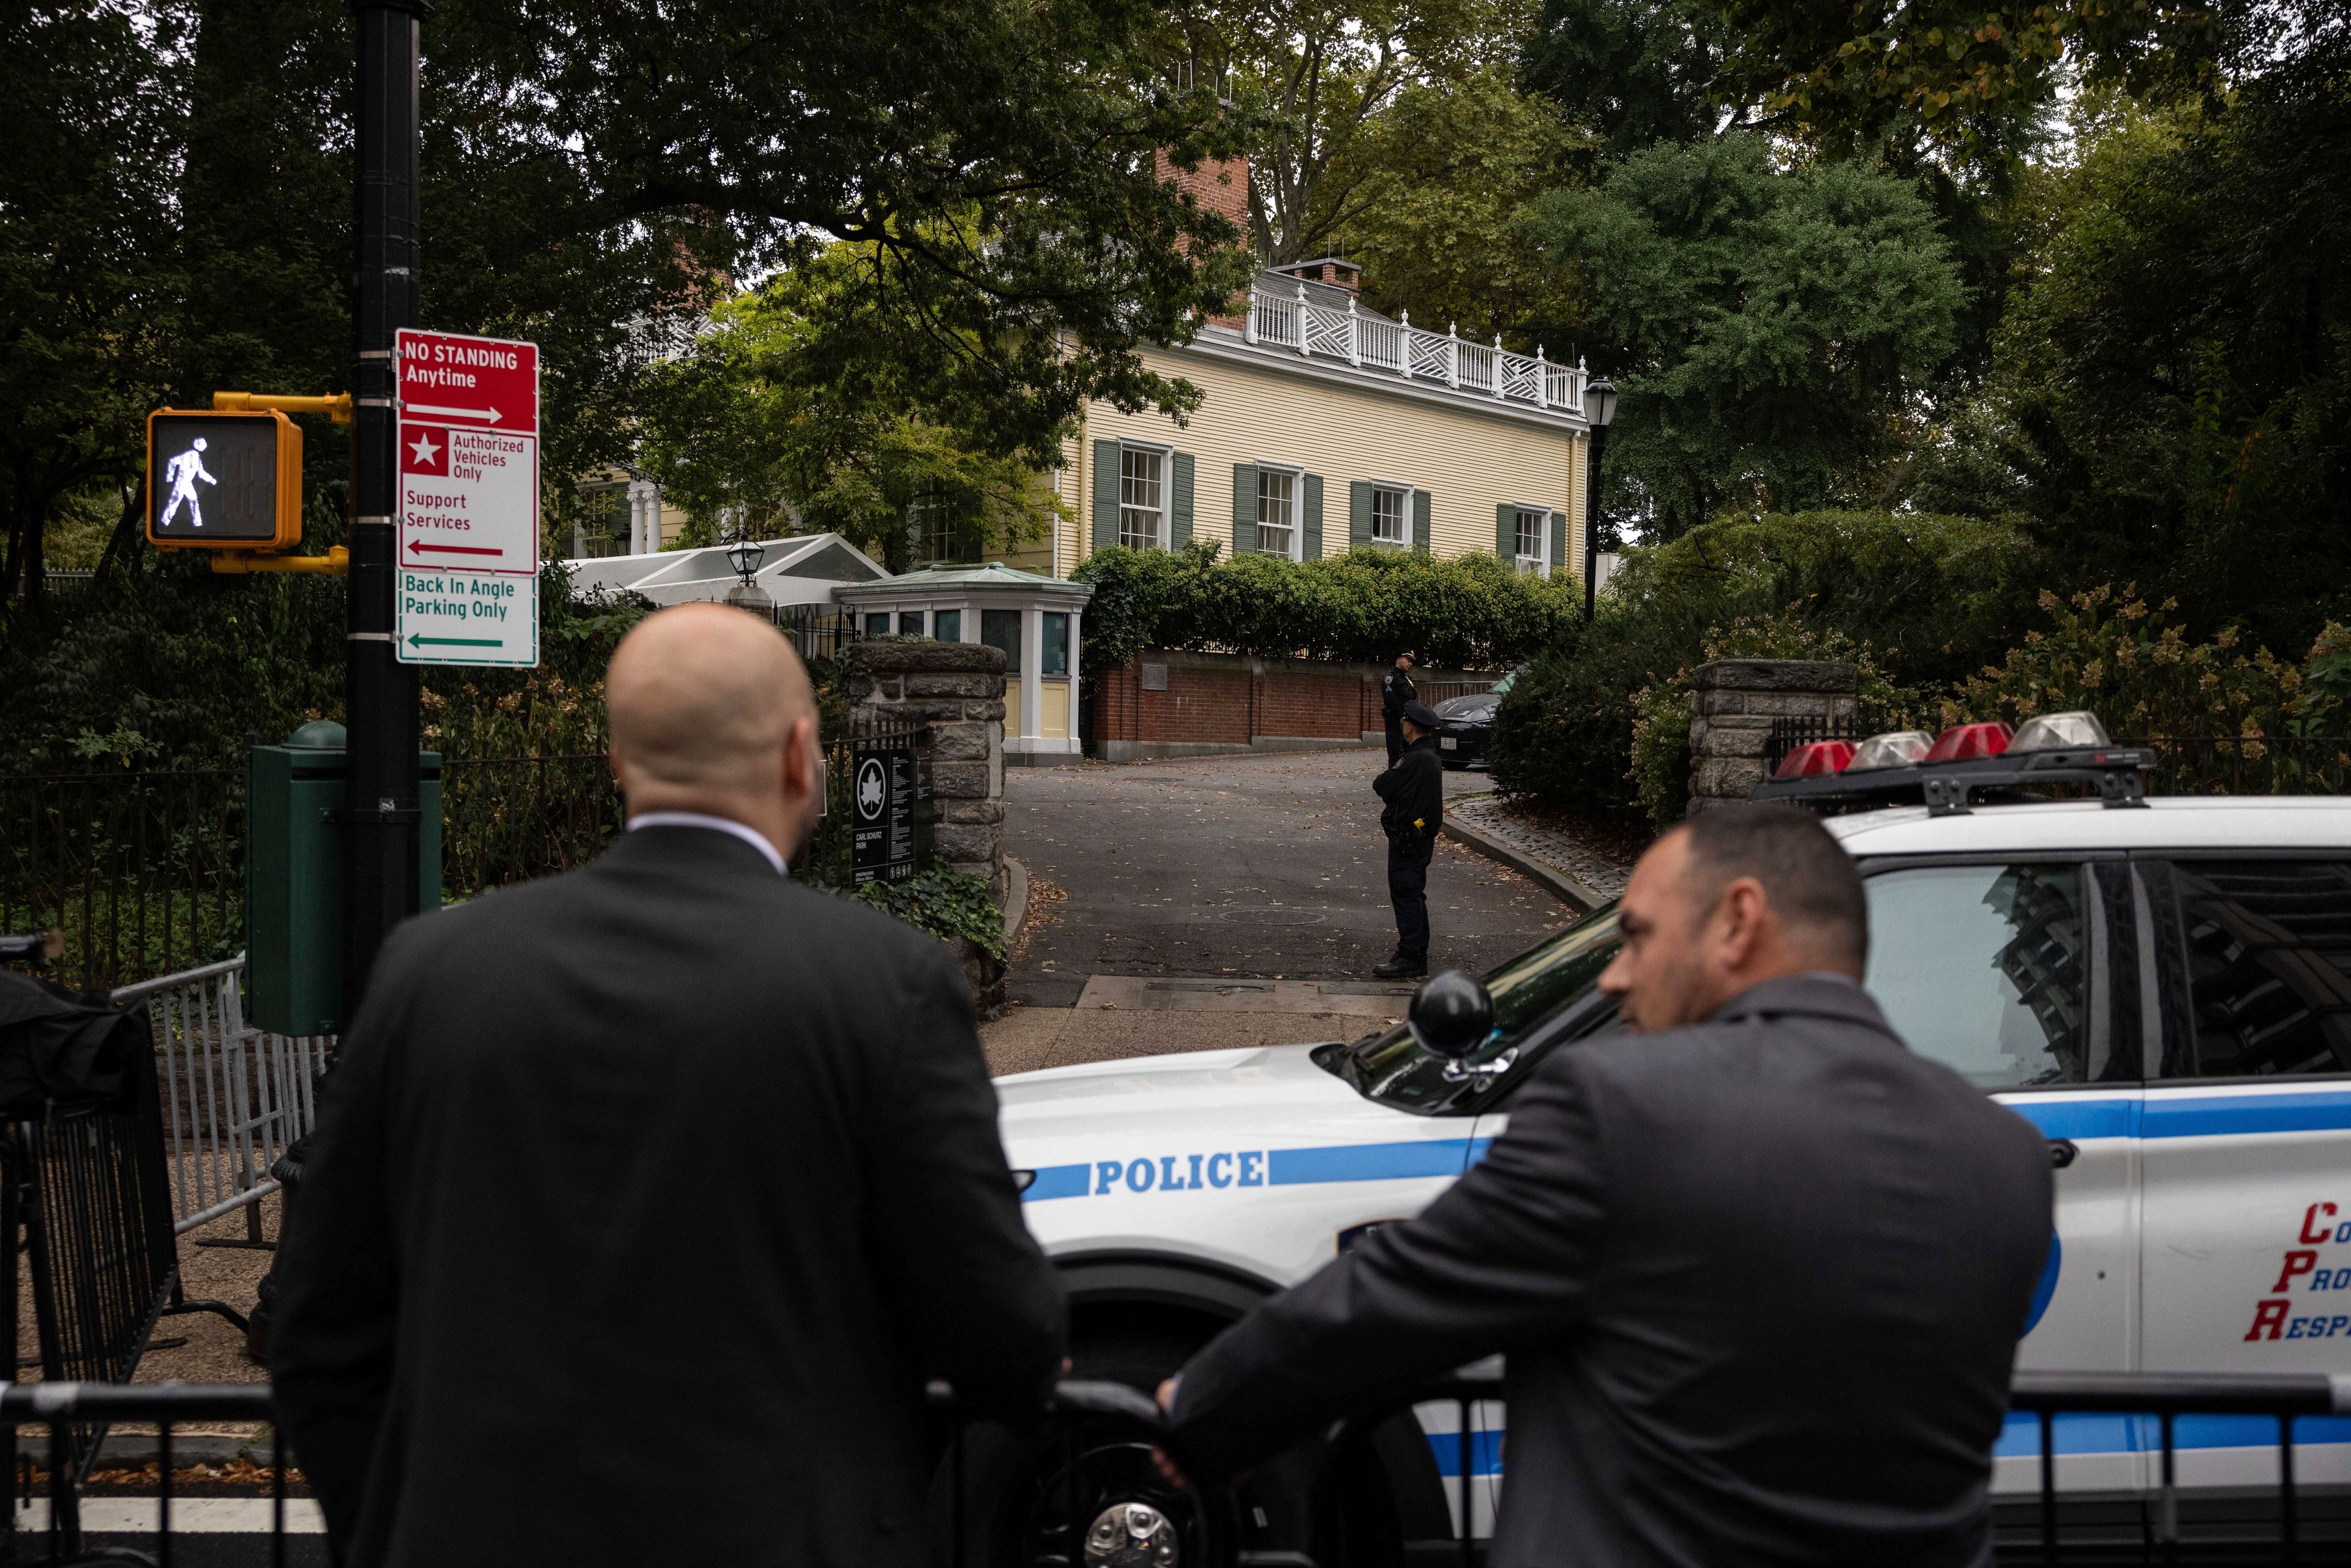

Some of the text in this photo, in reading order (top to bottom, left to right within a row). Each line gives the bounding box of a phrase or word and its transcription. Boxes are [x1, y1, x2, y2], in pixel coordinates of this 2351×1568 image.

[405, 341, 517, 370] NO STANDING
[406, 364, 477, 388] Anytime
[454, 434, 524, 453] Authorized
[454, 450, 506, 467] Vehicles
[453, 465, 482, 482] Only
[407, 490, 467, 509] Support
[407, 512, 471, 530] Services
[406, 575, 514, 600] Back In Angle
[406, 597, 507, 622] Parking Only
[866, 831, 882, 840] SCHURZ
[1095, 1150, 1264, 1196] POLICE
